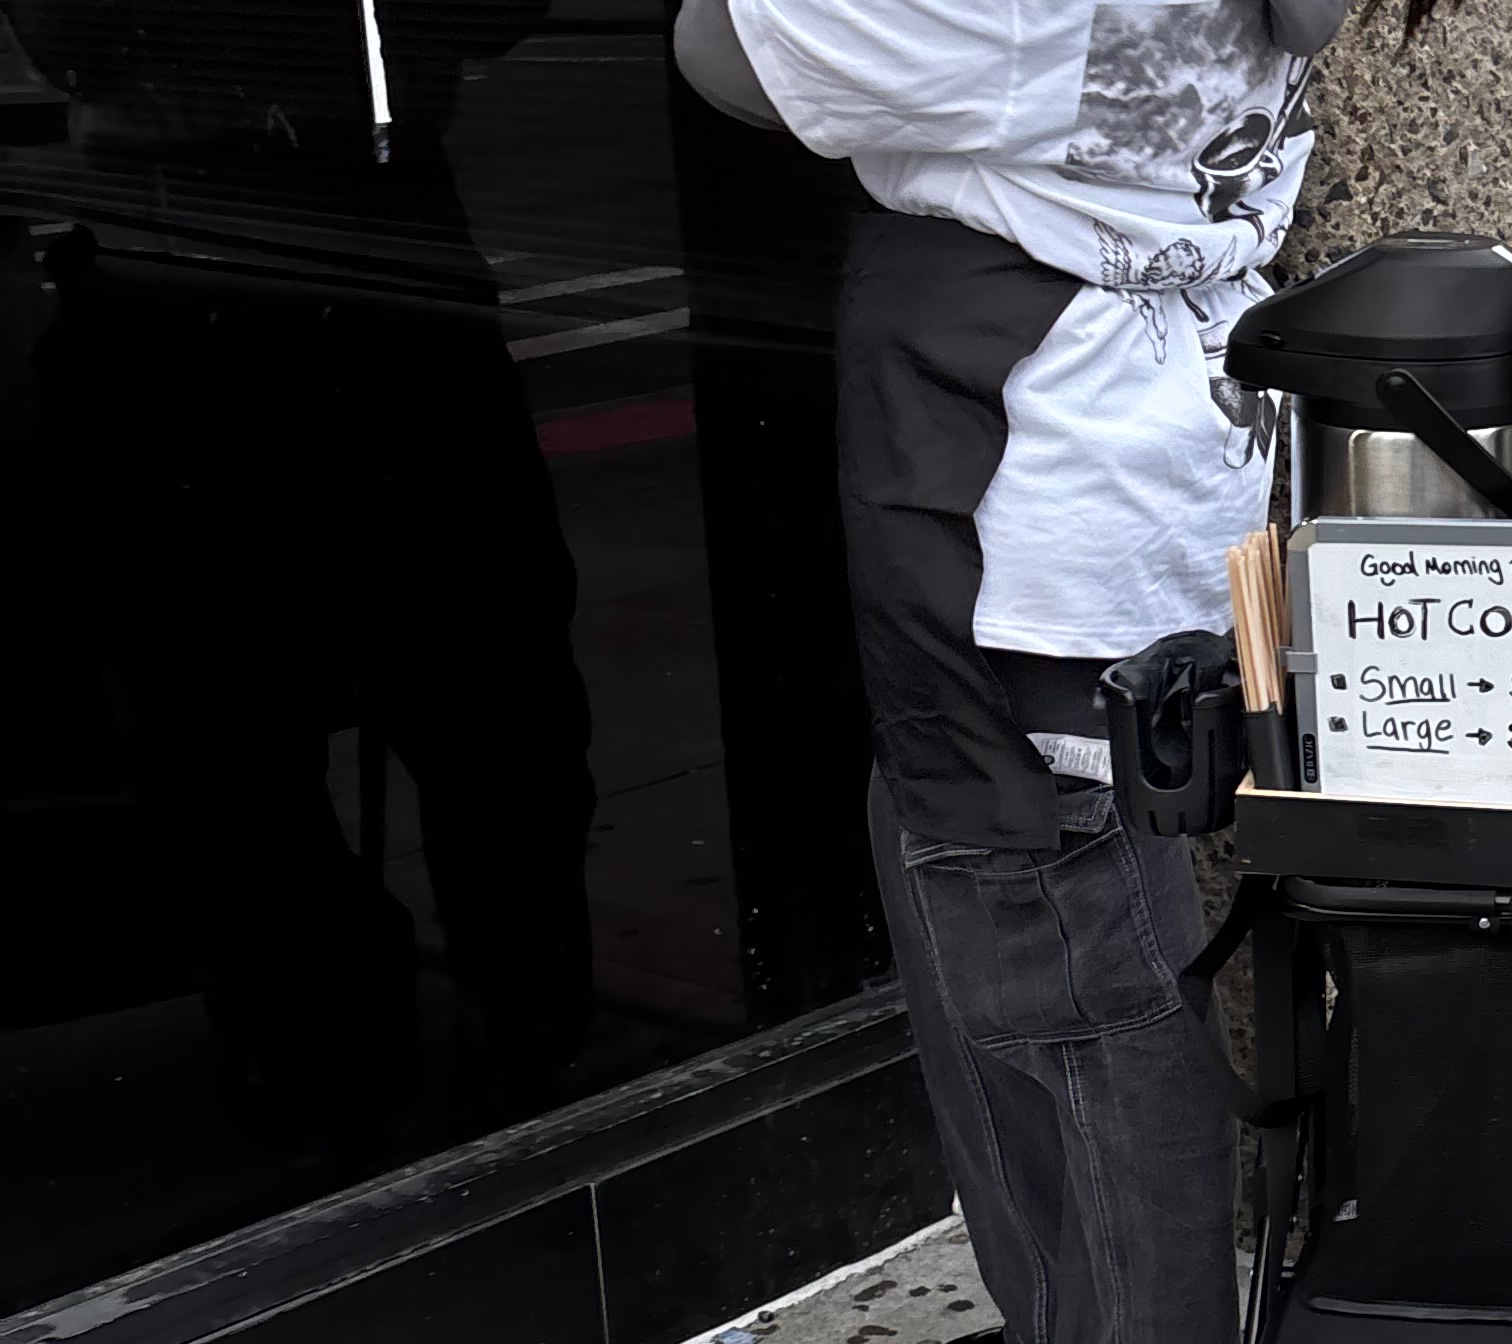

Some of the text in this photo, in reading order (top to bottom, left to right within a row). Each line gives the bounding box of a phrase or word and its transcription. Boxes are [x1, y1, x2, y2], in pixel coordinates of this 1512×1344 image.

[1360, 551, 1419, 577] Good
[1425, 556, 1505, 586] Morning
[1347, 598, 1441, 641] HOT
[1359, 666, 1456, 703] Small
[1362, 710, 1454, 751] Large
